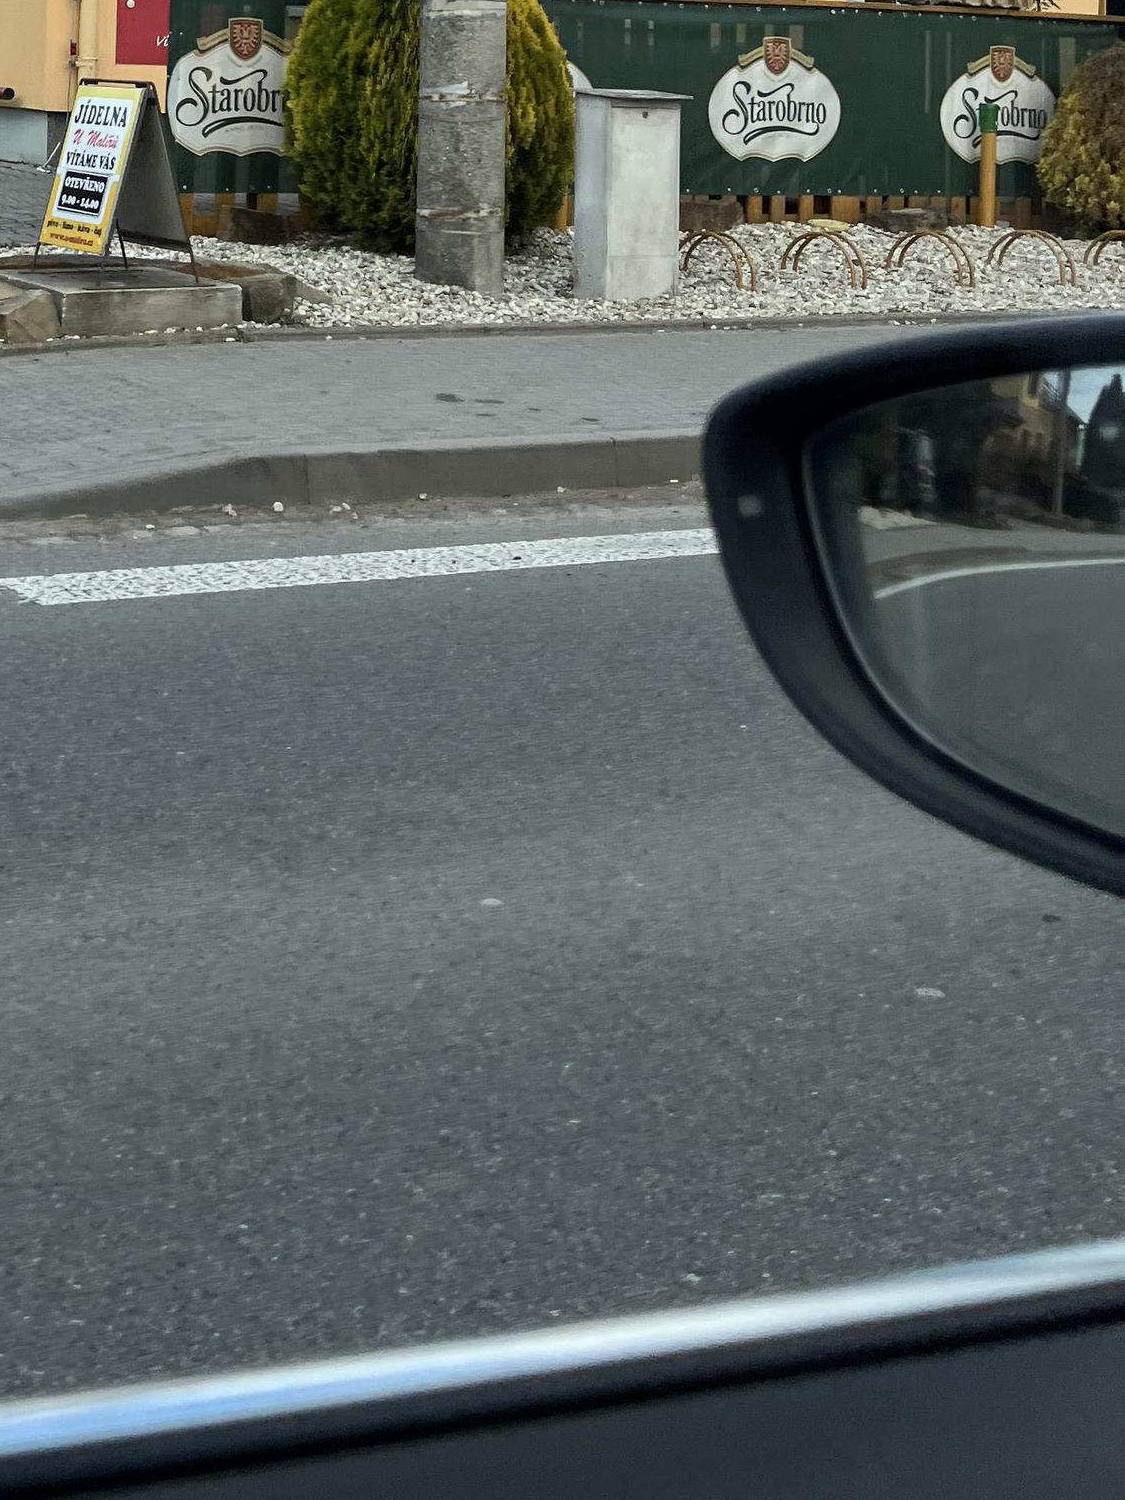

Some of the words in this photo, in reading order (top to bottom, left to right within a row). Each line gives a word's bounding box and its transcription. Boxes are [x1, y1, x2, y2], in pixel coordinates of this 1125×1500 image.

[74, 99, 128, 128] JÍDELNA
[722, 80, 827, 145] Starobrno
[73, 128, 85, 145] U
[66, 149, 98, 169] VÍTÁME
[99, 152, 117, 171] VÁS
[64, 176, 106, 194] OTEVŘENO
